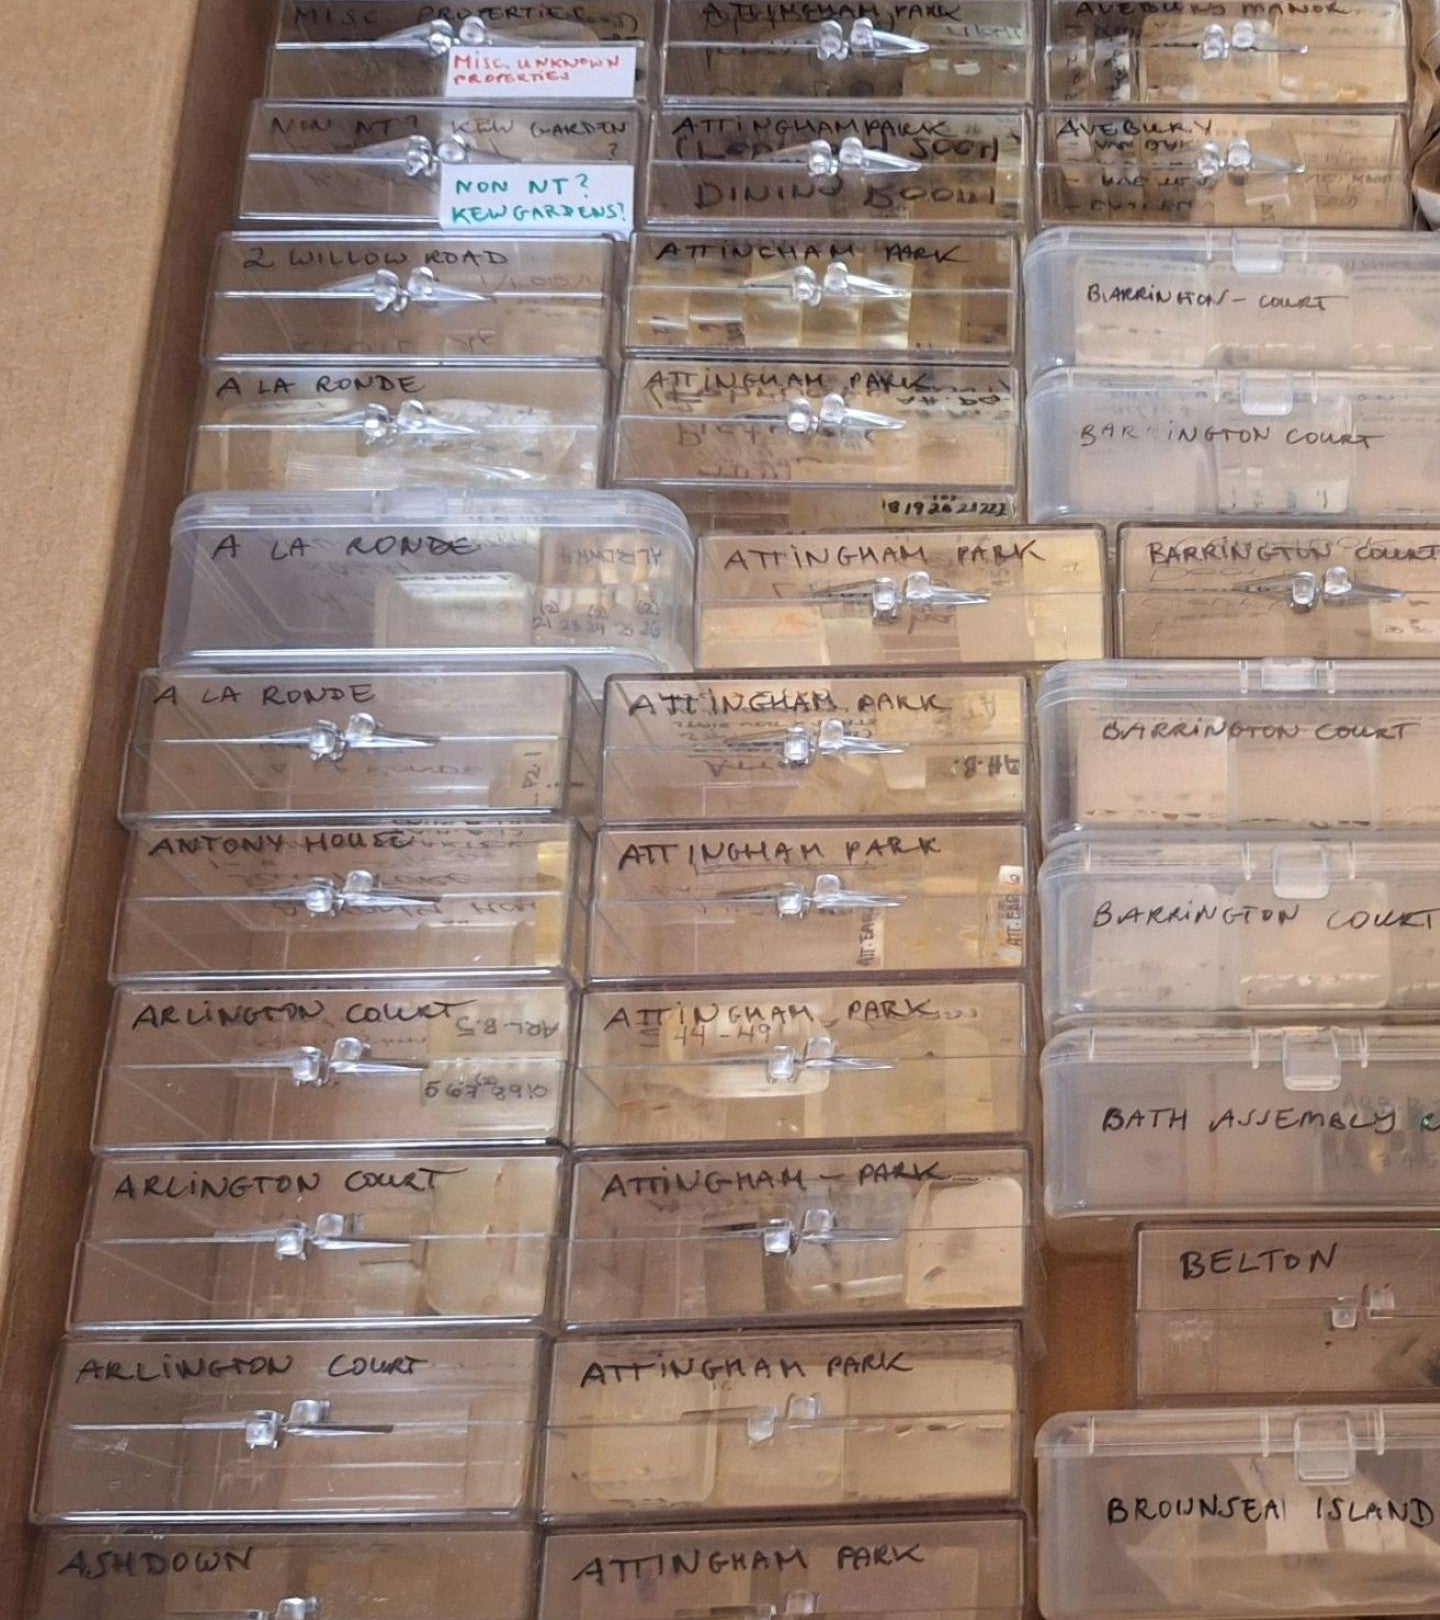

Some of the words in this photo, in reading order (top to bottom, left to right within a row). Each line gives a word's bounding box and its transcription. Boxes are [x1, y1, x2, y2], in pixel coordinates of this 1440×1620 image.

[517, 55, 621, 70] UNKNOWN
[453, 69, 571, 85] PROPERTIES
[450, 117, 514, 136] KEW
[1055, 119, 1213, 139] AVEBURY
[455, 177, 510, 195] NON
[450, 206, 509, 224] KEW
[242, 248, 276, 270] 2
[288, 248, 409, 268] WILLOW
[424, 248, 509, 268] ROAD
[654, 241, 856, 262] ATTINGHAM
[884, 243, 974, 264] PARK
[216, 376, 242, 396] A
[256, 377, 297, 395] LA
[315, 374, 427, 395] RONDE
[643, 365, 825, 391] ATTINGHAM
[1285, 428, 1387, 449] COURT
[213, 533, 241, 560] A
[270, 536, 310, 561] LA
[346, 533, 481, 558] RONDE
[722, 542, 930, 571] ATTINGHAM
[956, 539, 1047, 567] PARK
[1149, 537, 1331, 566] BARRINGTON
[152, 684, 178, 706] A
[201, 686, 240, 705] LA
[261, 683, 377, 705] RONDE
[1101, 716, 1300, 742] BARRINGTON
[1314, 720, 1421, 742] COURT
[147, 833, 286, 857] ANTONY
[618, 840, 822, 871] ATTINGHAM
[846, 836, 942, 861] PARK
[1092, 900, 1299, 929] BARRINGTON
[132, 1000, 324, 1030] ARLINGTON
[345, 999, 478, 1027] COURT
[604, 1000, 814, 1031] ATTINGHAM
[847, 998, 934, 1019] PARK
[1101, 1105, 1189, 1133] BATH
[1208, 1107, 1397, 1133] ASSEMBLY
[113, 1170, 321, 1200] ARLINGTON
[345, 1167, 469, 1193] COURT
[601, 1166, 808, 1202] ATTINGHAM
[858, 1160, 953, 1185] PARK
[1179, 1241, 1339, 1280] BELTON
[75, 1354, 293, 1384] ARLINGTON
[328, 1353, 430, 1378] COURT
[579, 1352, 807, 1390] ATTINGHAM
[826, 1351, 914, 1378] PARK
[1316, 1495, 1437, 1528] ISLAND
[57, 1545, 256, 1581] ASHDOWN
[571, 1545, 809, 1588] ATTINGHAM
[836, 1542, 926, 1570] PARK
